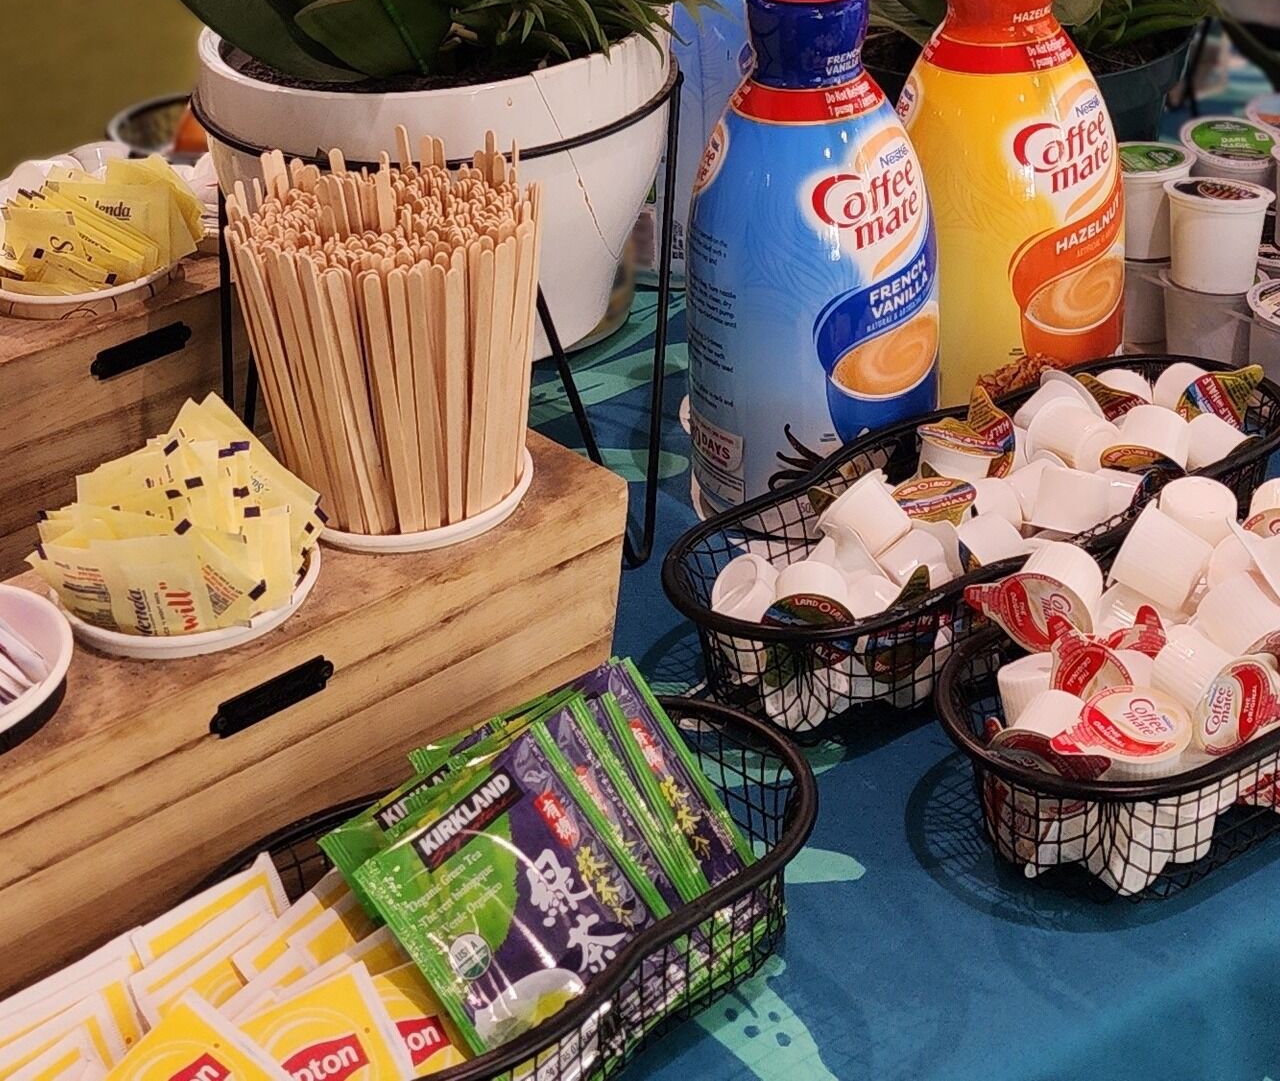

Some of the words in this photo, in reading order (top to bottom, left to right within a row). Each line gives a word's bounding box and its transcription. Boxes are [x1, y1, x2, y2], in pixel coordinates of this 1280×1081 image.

[1013, 5, 1052, 23] HAZELN
[827, 48, 860, 65] FRENC
[1013, 110, 1107, 173] Coffee
[1051, 140, 1110, 194] mate
[812, 158, 916, 229] Coffee
[855, 190, 919, 251] mate
[1056, 191, 1121, 256] HAZELNUT
[869, 253, 927, 306] FRENCH
[871, 273, 929, 320] VANILLA
[127, 587, 153, 636] lenda
[1122, 711, 1155, 737] mate
[1129, 698, 1169, 733] Coffee
[1205, 686, 1227, 736] Coffee
[1221, 686, 1234, 724] mate
[419, 772, 511, 857] KIRKLAND
[406, 881, 445, 916] Organic
[438, 861, 467, 887] Green
[463, 847, 483, 866] Tea
[455, 940, 478, 962] USA
[291, 1045, 360, 1081] pton
